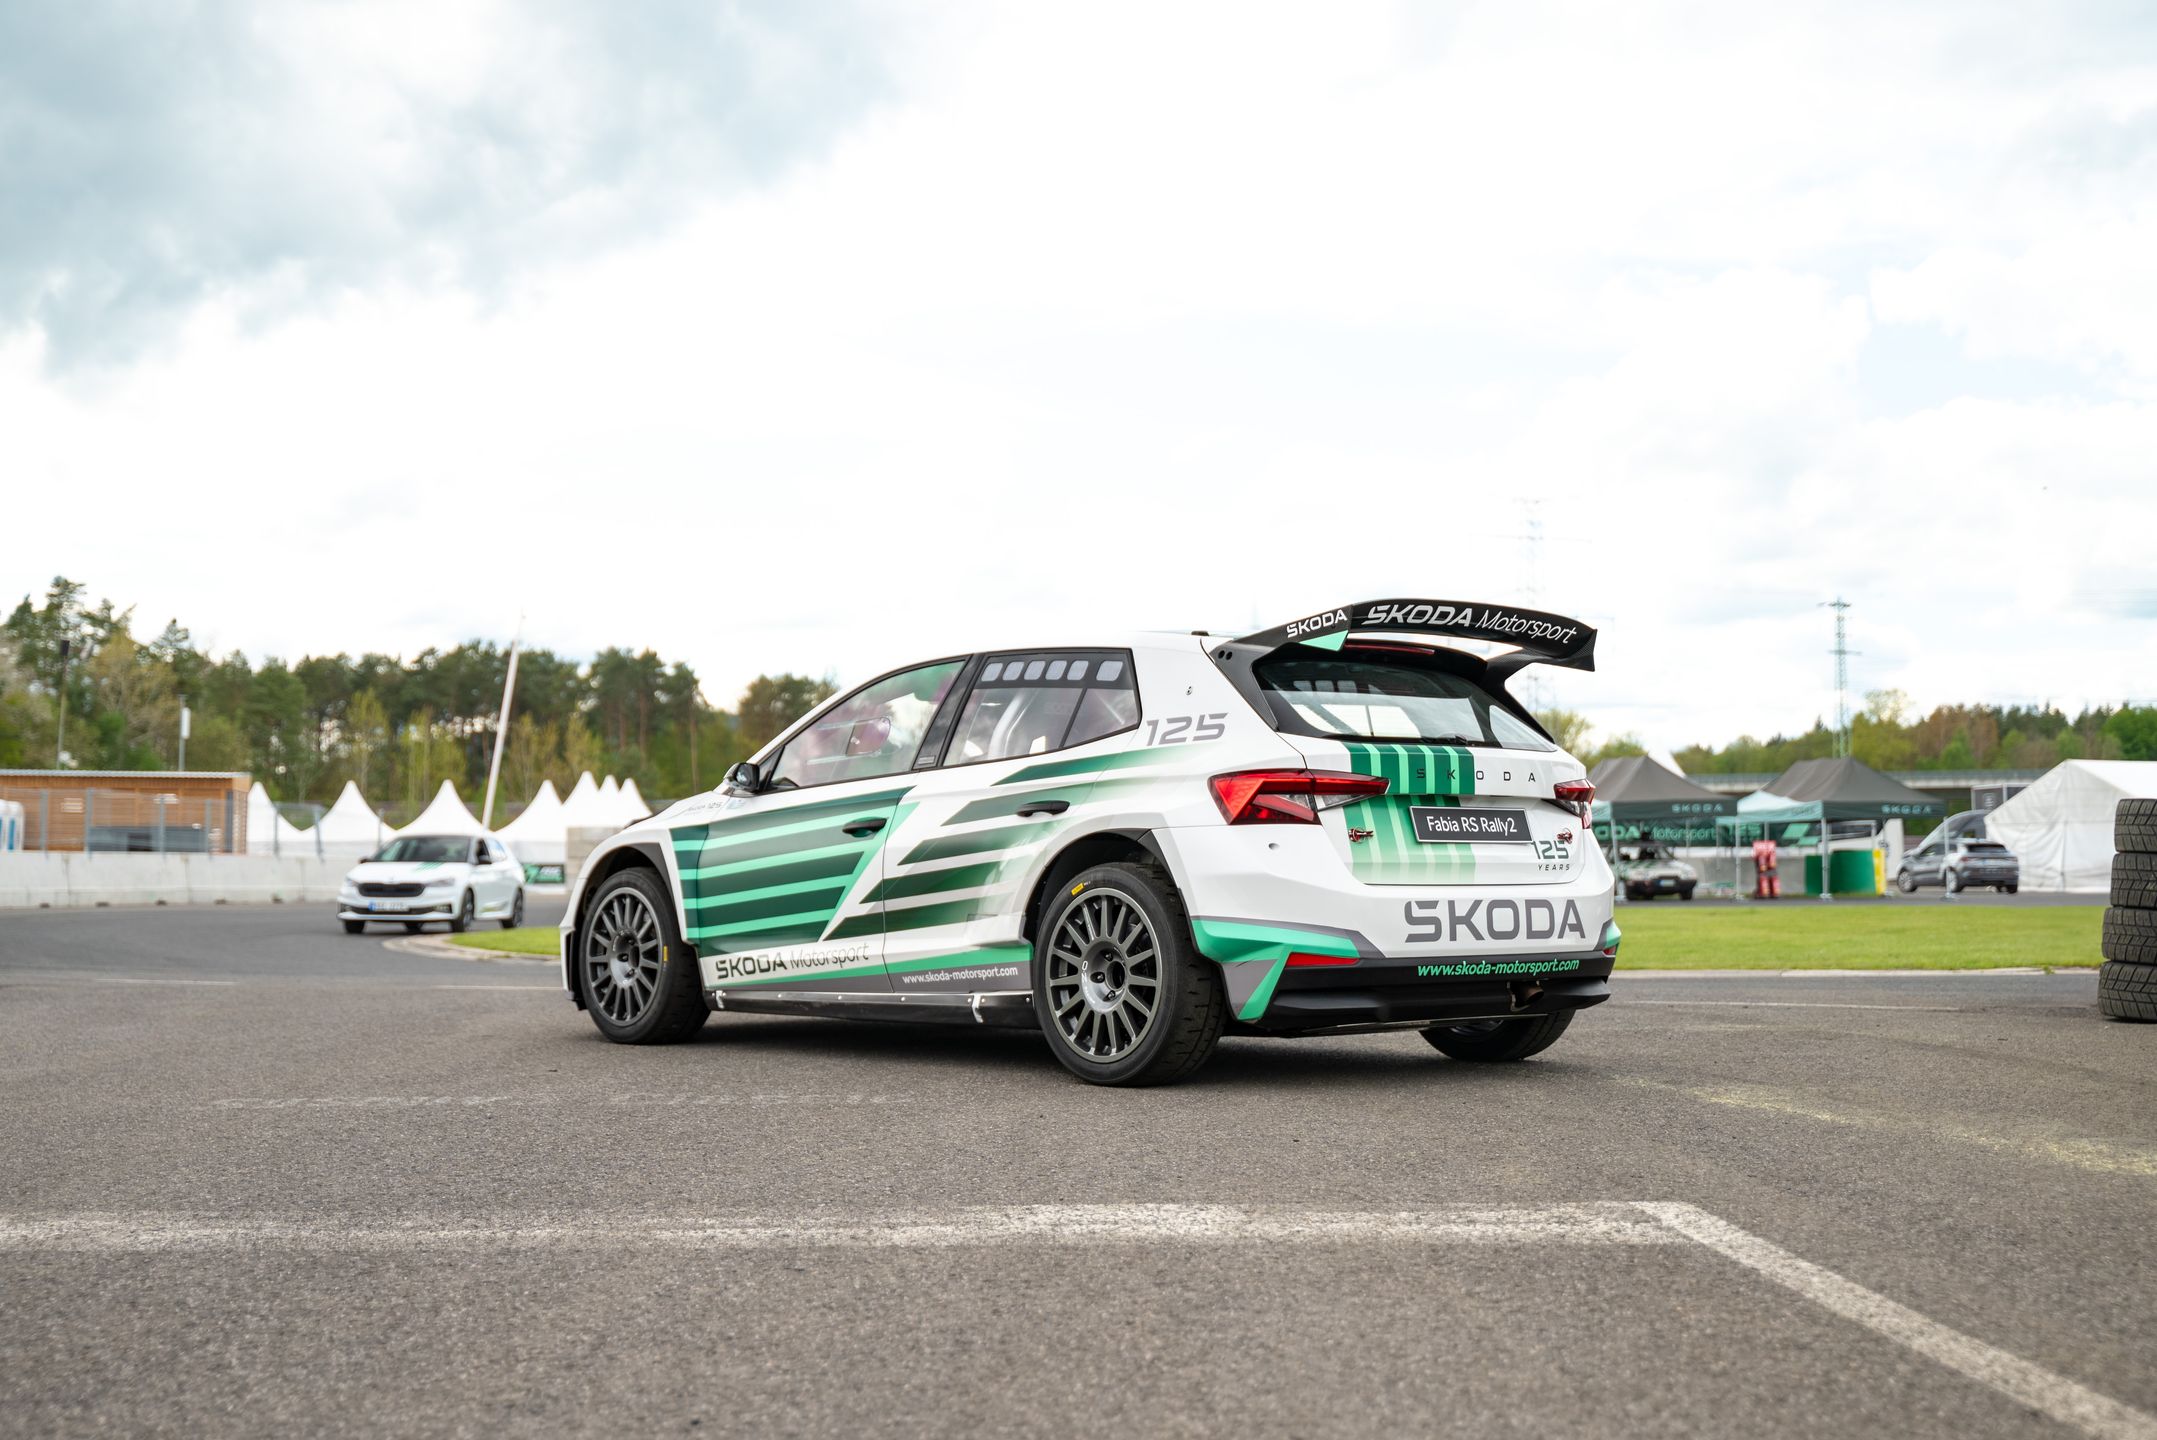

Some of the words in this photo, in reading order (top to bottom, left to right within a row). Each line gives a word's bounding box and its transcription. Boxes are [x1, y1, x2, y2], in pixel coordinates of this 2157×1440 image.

[1286, 609, 1348, 638] SKODA
[1362, 604, 1474, 627] SKODA
[1475, 609, 1577, 644] Motorsport
[1146, 712, 1229, 746] 125
[1416, 768, 1536, 783] SKODA
[1426, 815, 1460, 832] Fabia
[1461, 816, 1479, 833] RS
[1480, 817, 1517, 836] Rally2
[1531, 840, 1570, 860] 125
[1538, 863, 1570, 871] YEARS
[1404, 899, 1586, 943] SKODA
[715, 952, 787, 979] SKODA
[790, 942, 870, 972] Motorsport
[1417, 958, 1579, 976] www.skoda-motorsport.com
[902, 966, 1018, 985] www.skoda-motorsport.com
